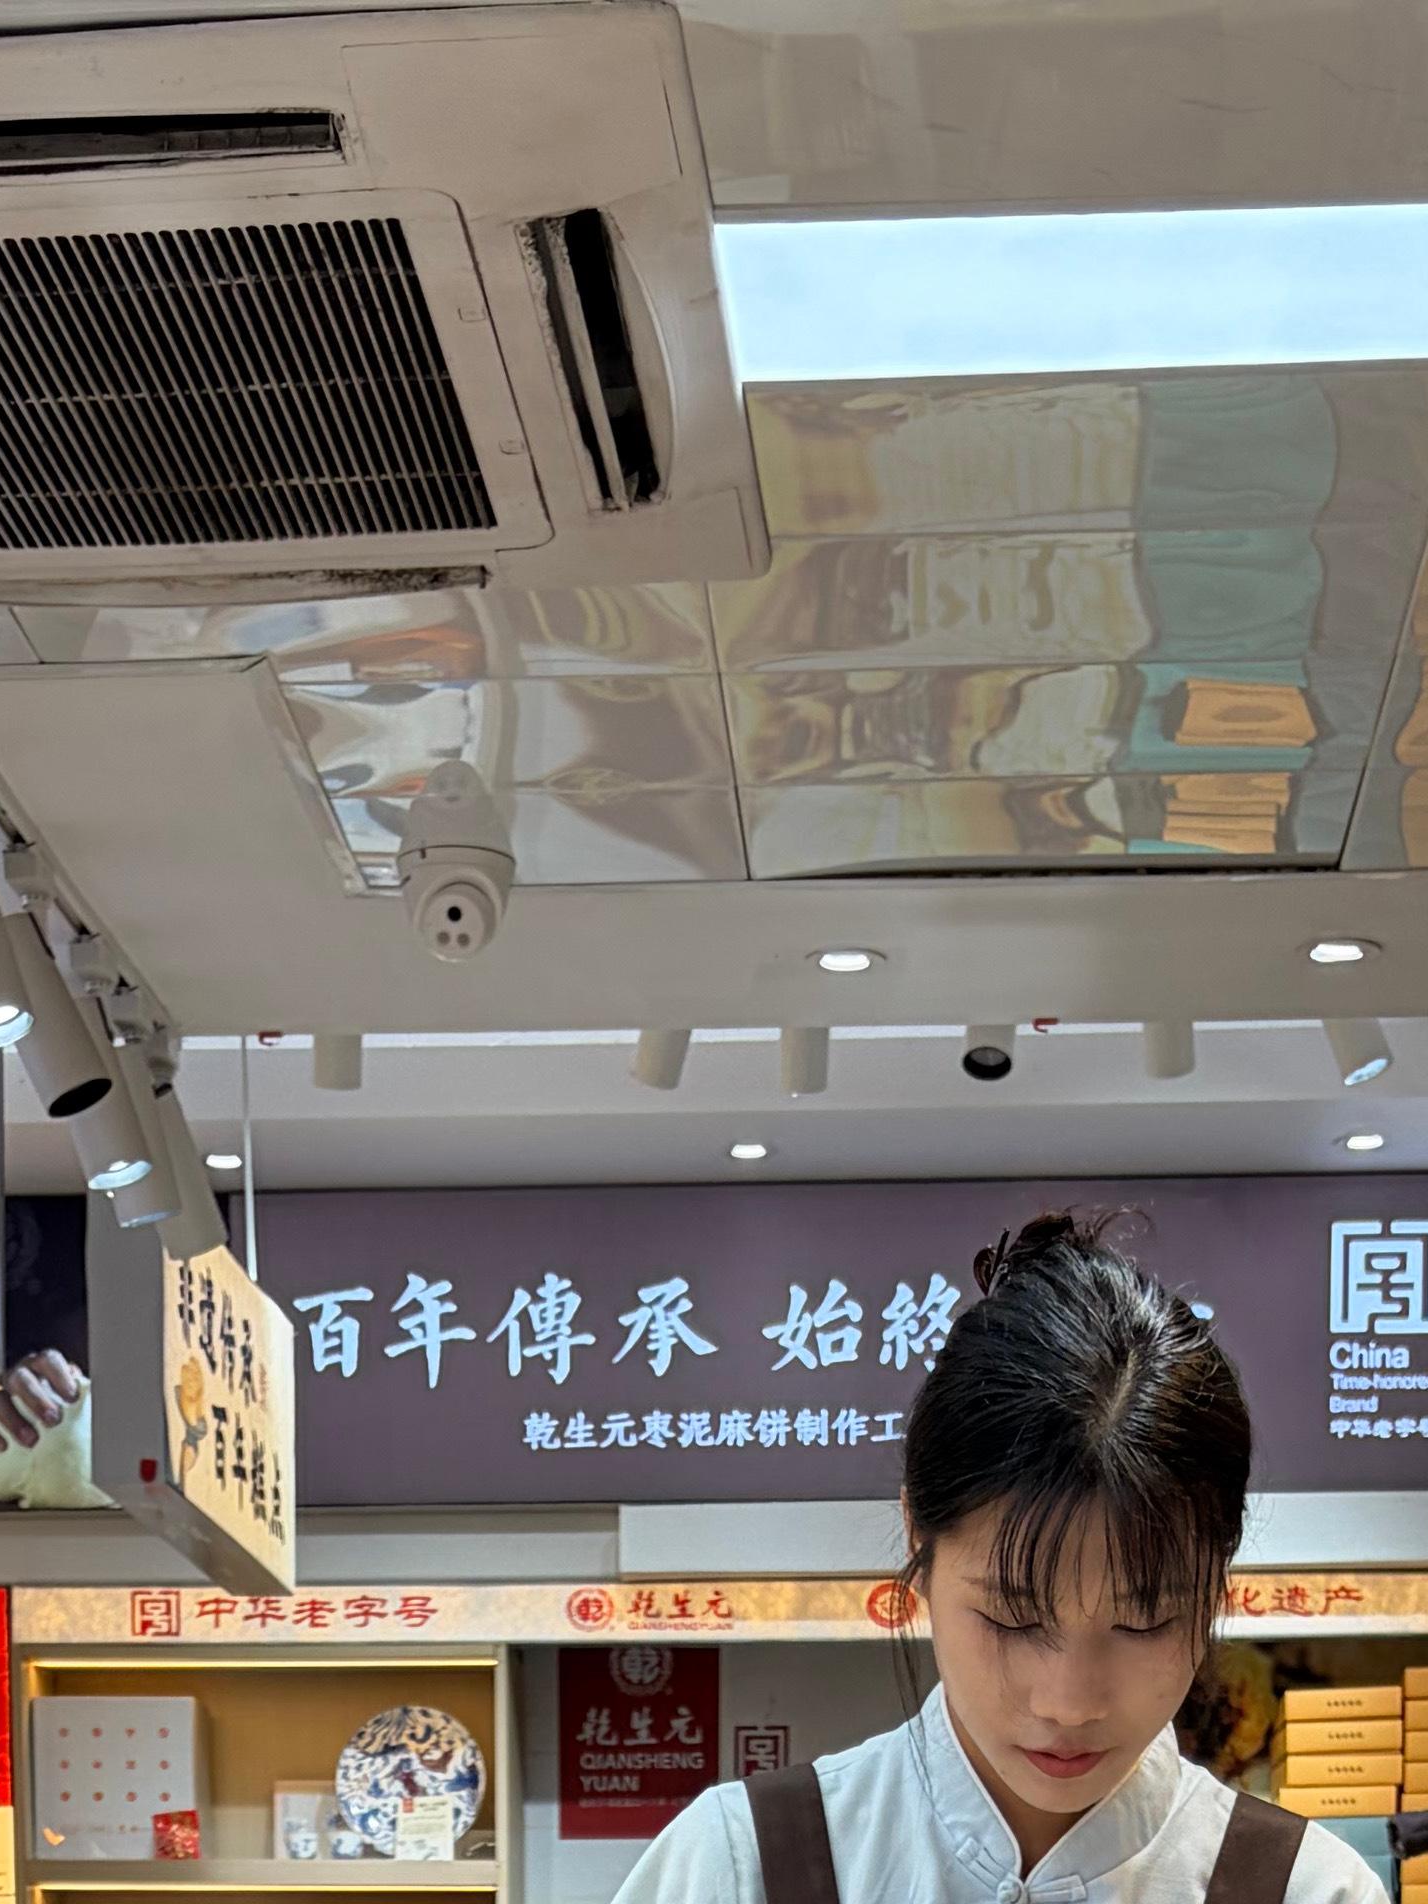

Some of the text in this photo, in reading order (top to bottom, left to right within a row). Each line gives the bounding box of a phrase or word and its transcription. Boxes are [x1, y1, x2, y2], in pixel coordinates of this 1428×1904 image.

[293, 1271, 718, 1389] 百年傳承
[1329, 1340, 1410, 1369] China
[1329, 1395, 1379, 1413] Brand
[194, 1594, 439, 1631] 中华老字号
[626, 1589, 734, 1620] 乾生元
[576, 1706, 704, 1747] 乾生元
[579, 1752, 705, 1771] QIANSHENG
[579, 1773, 640, 1793] YUAN
